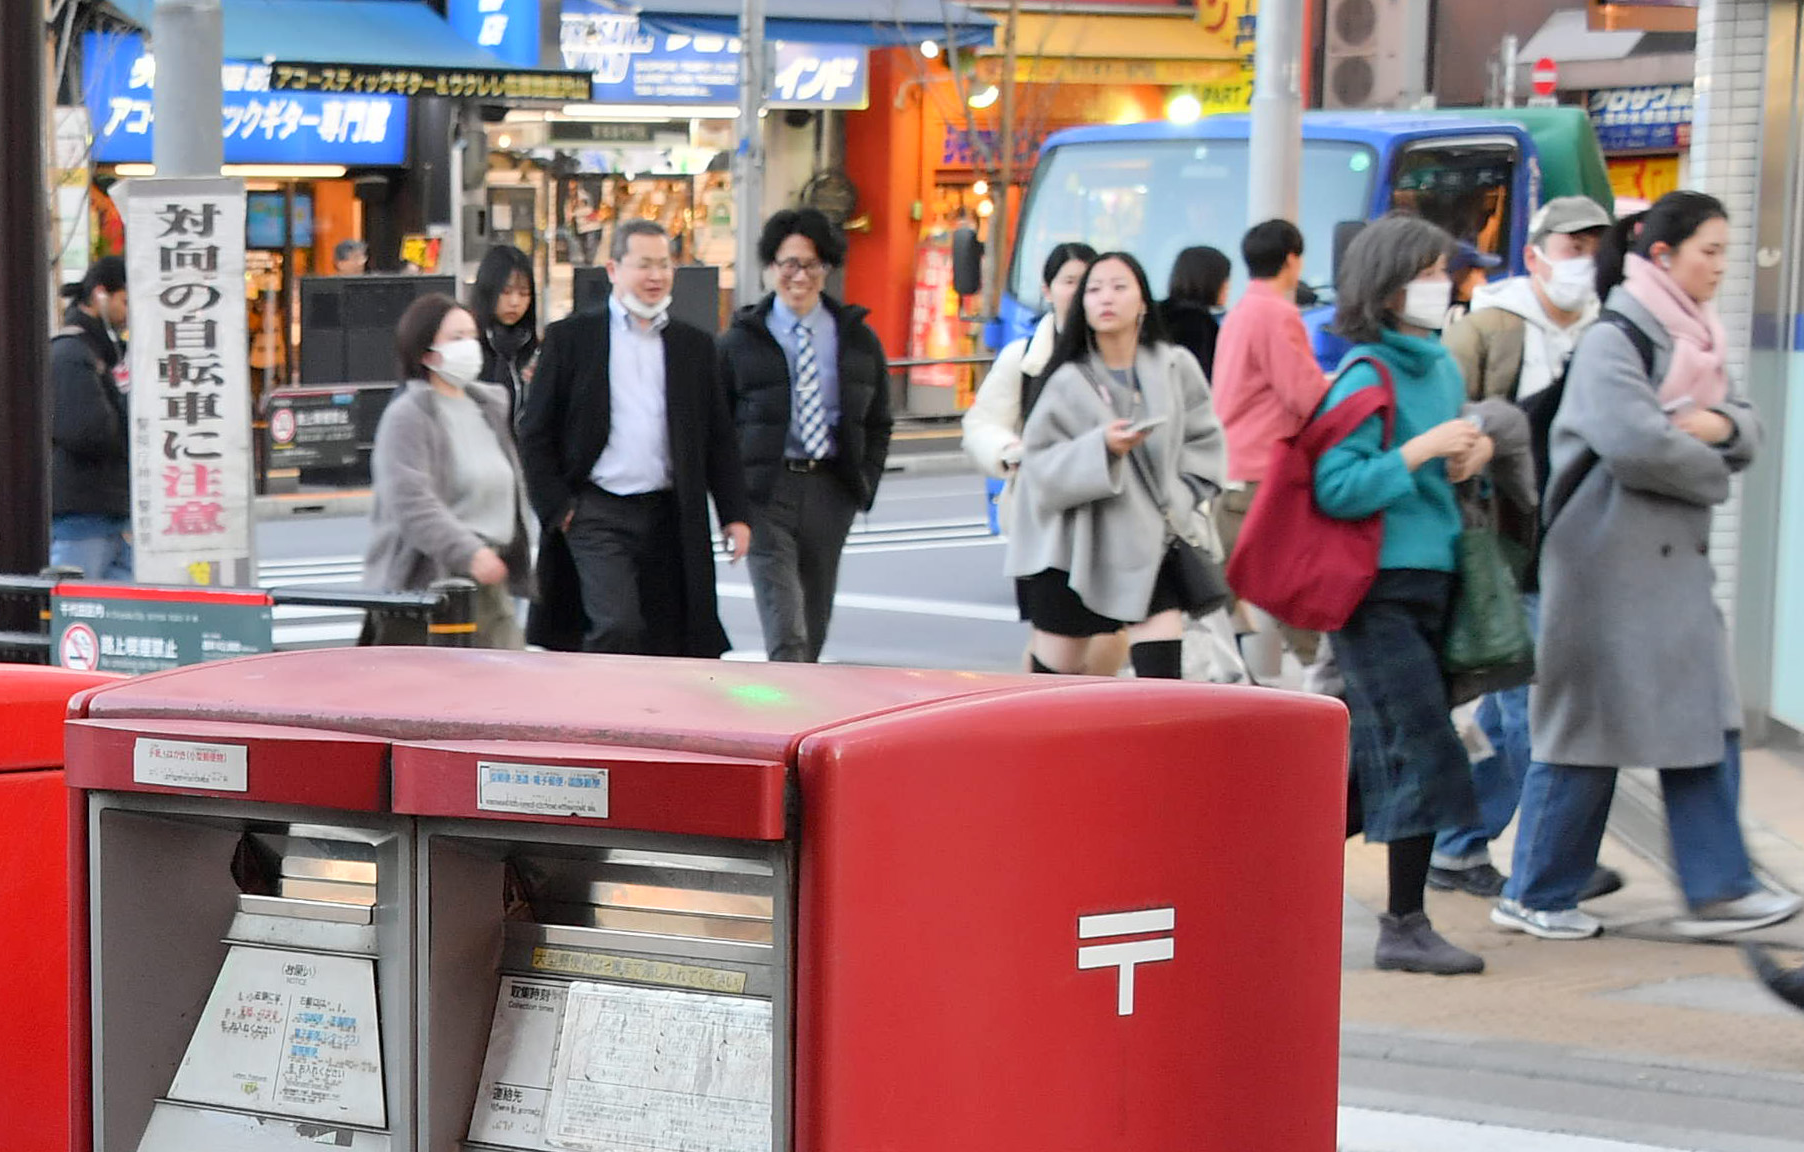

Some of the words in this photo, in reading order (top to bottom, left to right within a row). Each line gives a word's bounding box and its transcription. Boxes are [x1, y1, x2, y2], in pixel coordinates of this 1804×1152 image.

[154, 203, 228, 536] 対向の自転車に注意
